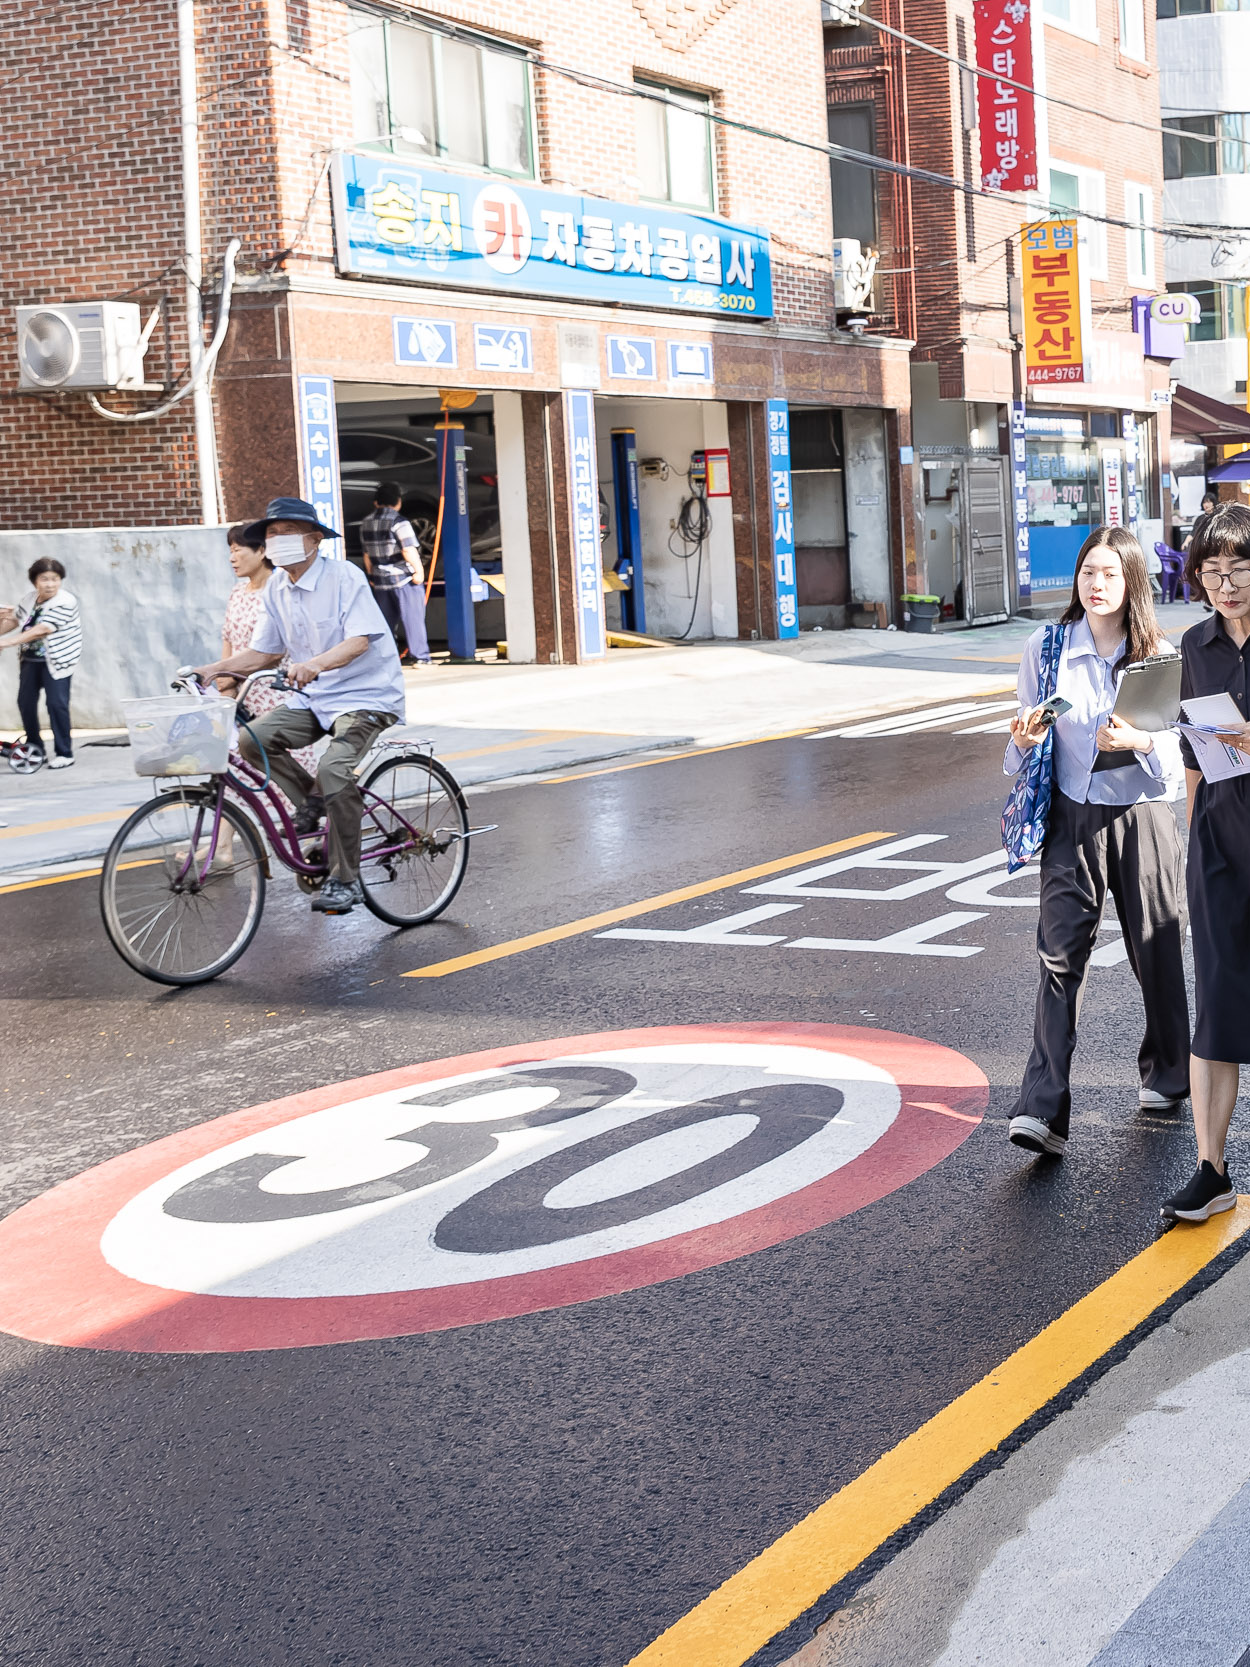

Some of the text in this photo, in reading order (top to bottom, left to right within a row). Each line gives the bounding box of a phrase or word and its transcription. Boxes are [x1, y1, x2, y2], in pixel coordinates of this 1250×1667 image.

[990, 18, 1020, 171] 스타노래방
[1023, 174, 1037, 187] B1
[540, 210, 756, 290] 자동차공업사
[1027, 226, 1074, 251] 모범
[1030, 253, 1075, 362] 부동산
[1159, 302, 1184, 316] CU
[1028, 365, 1082, 382] 444-9767
[163, 1065, 845, 1253] 30
